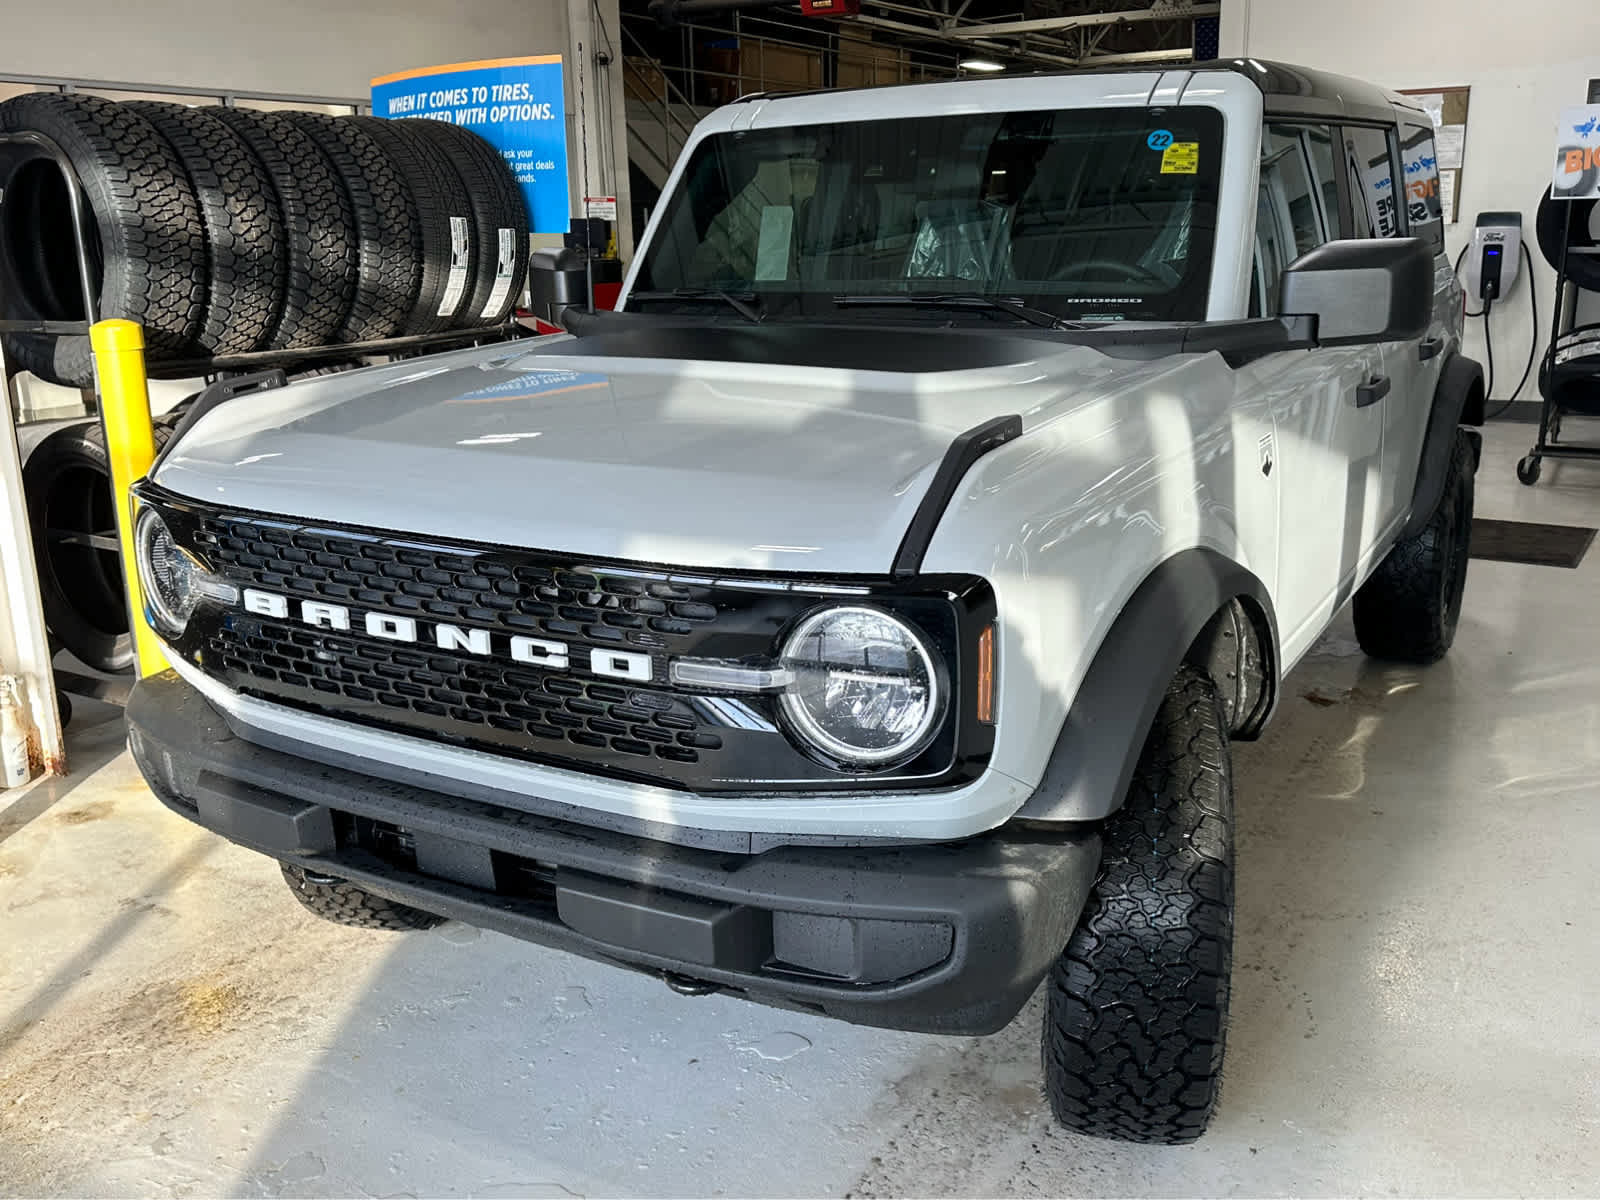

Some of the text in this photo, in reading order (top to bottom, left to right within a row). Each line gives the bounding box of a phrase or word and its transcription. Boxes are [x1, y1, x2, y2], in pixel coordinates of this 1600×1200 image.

[388, 83, 534, 114] WHEN IT COMES TO TIRES,
[455, 107, 487, 126] WITH
[490, 103, 555, 122] OPTIONS.
[1151, 134, 1170, 146] 22
[503, 149, 516, 159] ask
[517, 149, 533, 160] your
[515, 161, 534, 172] great
[536, 159, 555, 170] deals
[514, 173, 536, 183] rands.
[243, 587, 653, 682] BRONCO
